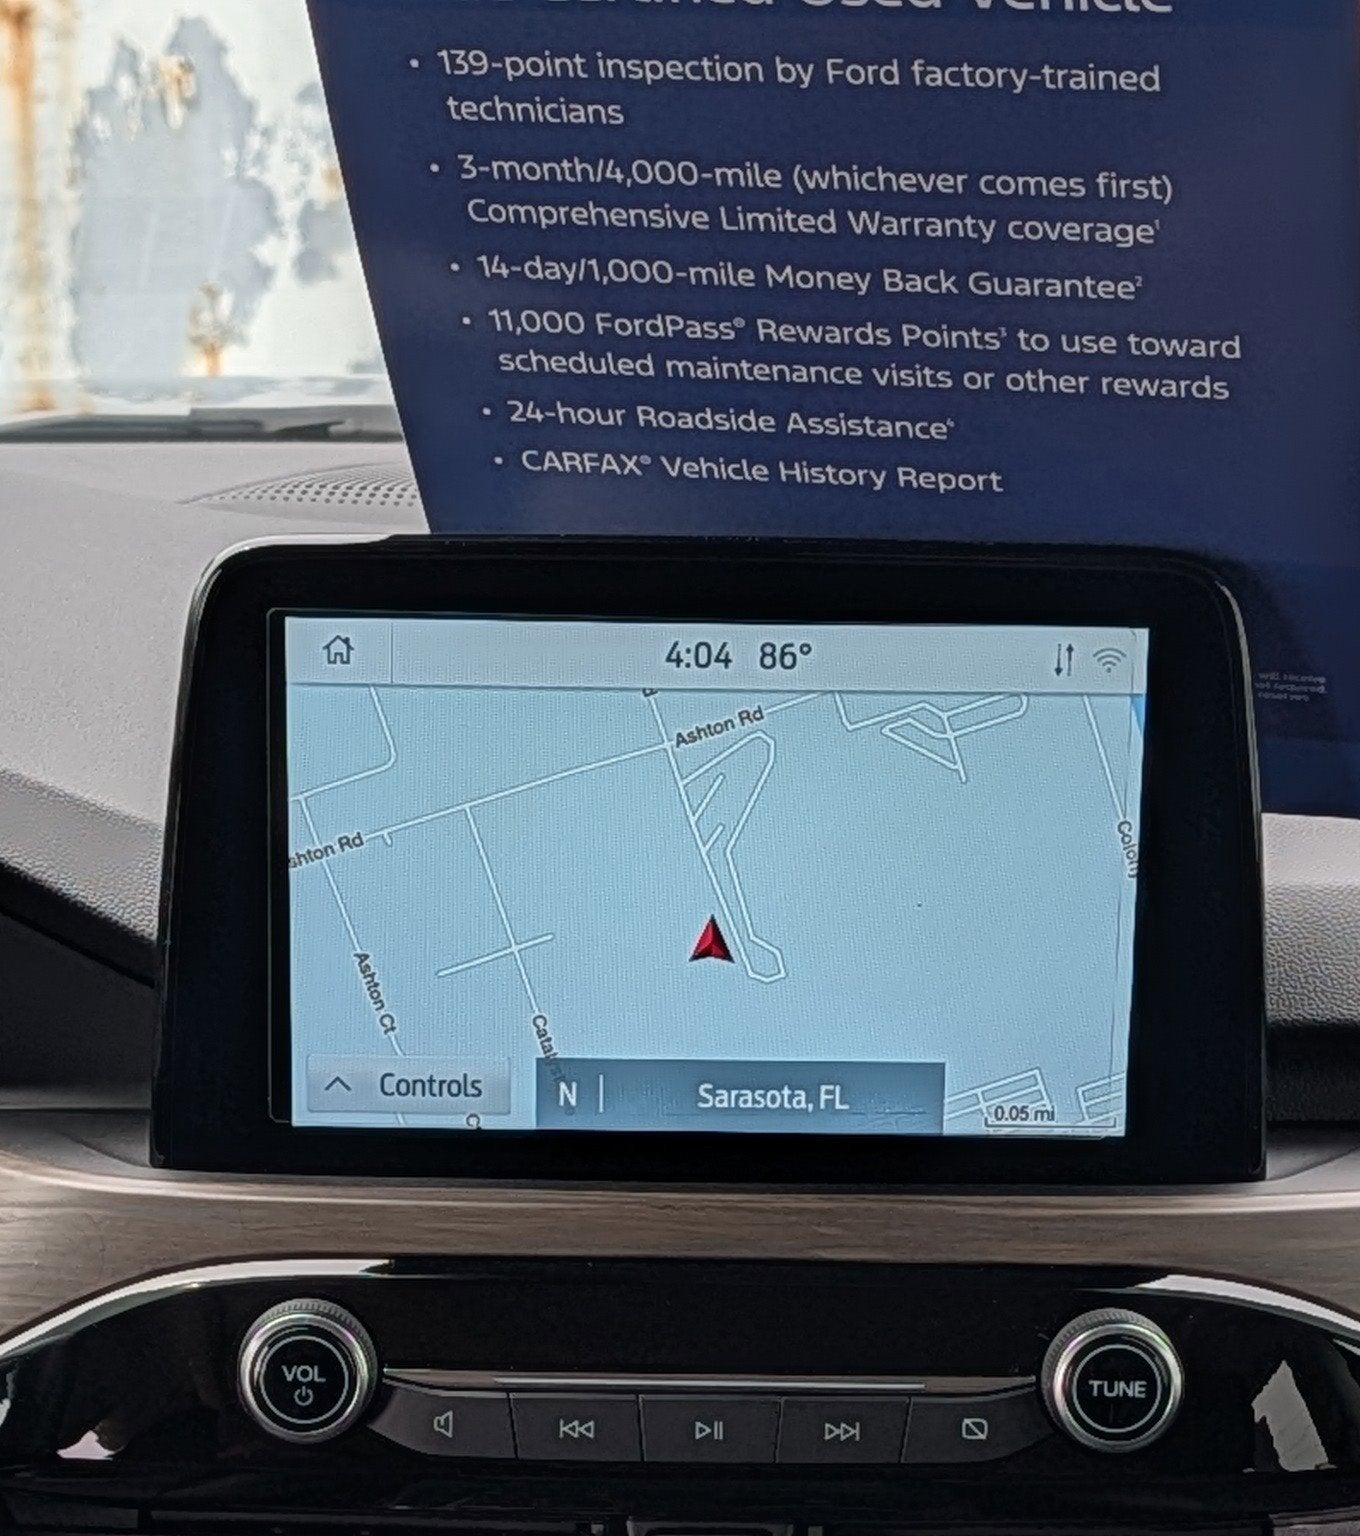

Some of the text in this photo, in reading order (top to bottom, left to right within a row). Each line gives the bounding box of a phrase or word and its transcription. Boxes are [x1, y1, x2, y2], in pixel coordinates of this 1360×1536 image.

[437, 49, 1161, 94] 139-point inspection by Ford factory-trained
[447, 96, 625, 125] technicians
[457, 155, 1173, 204] 3-month/4,000-mile (whichever comes first)
[468, 199, 710, 231] Comprehensive
[720, 205, 837, 235] Limited
[847, 211, 996, 243] Warranty
[476, 254, 756, 288] 14-day/1,000-mile
[766, 265, 871, 295] Money
[883, 268, 958, 296] Back
[488, 309, 584, 336] 11,000
[756, 319, 891, 347] Rewards
[1018, 329, 1050, 353] to
[1061, 332, 1118, 355] use
[1128, 333, 1241, 360] toward
[498, 349, 1230, 400] scheduled maintenance visits or other rewards
[507, 400, 626, 427] 24-hour
[637, 405, 776, 434] Roadside
[660, 455, 769, 482] Vehicle
[778, 461, 887, 491] History
[897, 466, 1004, 493] Report
[665, 641, 813, 670] 4:04 86°
[676, 705, 764, 748] Ashton Rd
[289, 831, 364, 868] shton Rd
[353, 953, 397, 1035] Ashton Ct
[380, 1072, 483, 1098] Controls
[558, 1081, 578, 1107] N
[697, 1083, 849, 1111] Sarasota, FL
[993, 1105, 1055, 1123] 0.05 mi
[281, 1365, 326, 1384] VOL
[1088, 1380, 1146, 1399] TUNE
